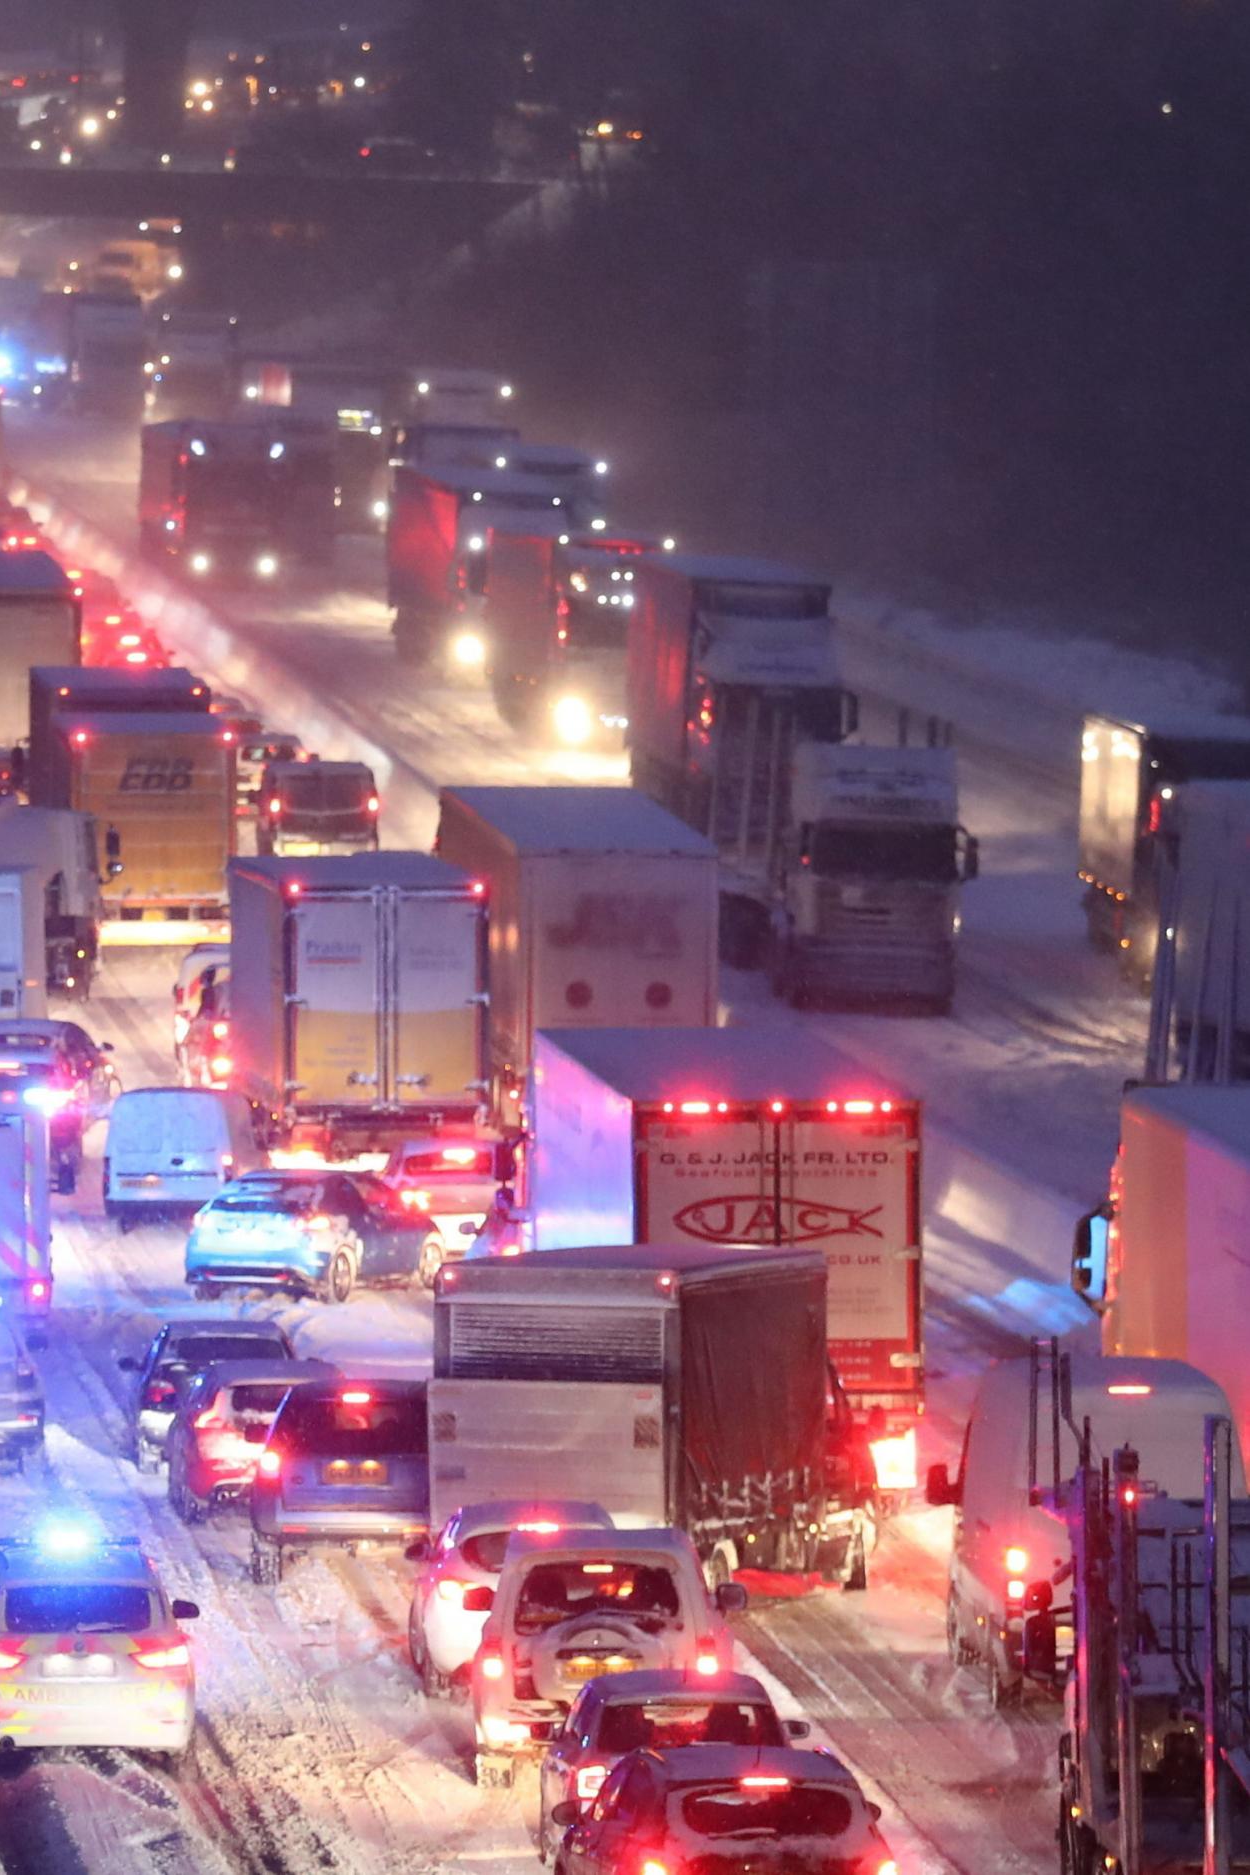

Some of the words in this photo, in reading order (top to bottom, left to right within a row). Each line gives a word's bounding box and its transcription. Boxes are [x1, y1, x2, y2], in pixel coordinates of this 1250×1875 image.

[687, 1151, 704, 1166] &
[709, 1151, 729, 1166] J.
[733, 1150, 796, 1166] JACK
[700, 1203, 884, 1240] JACK
